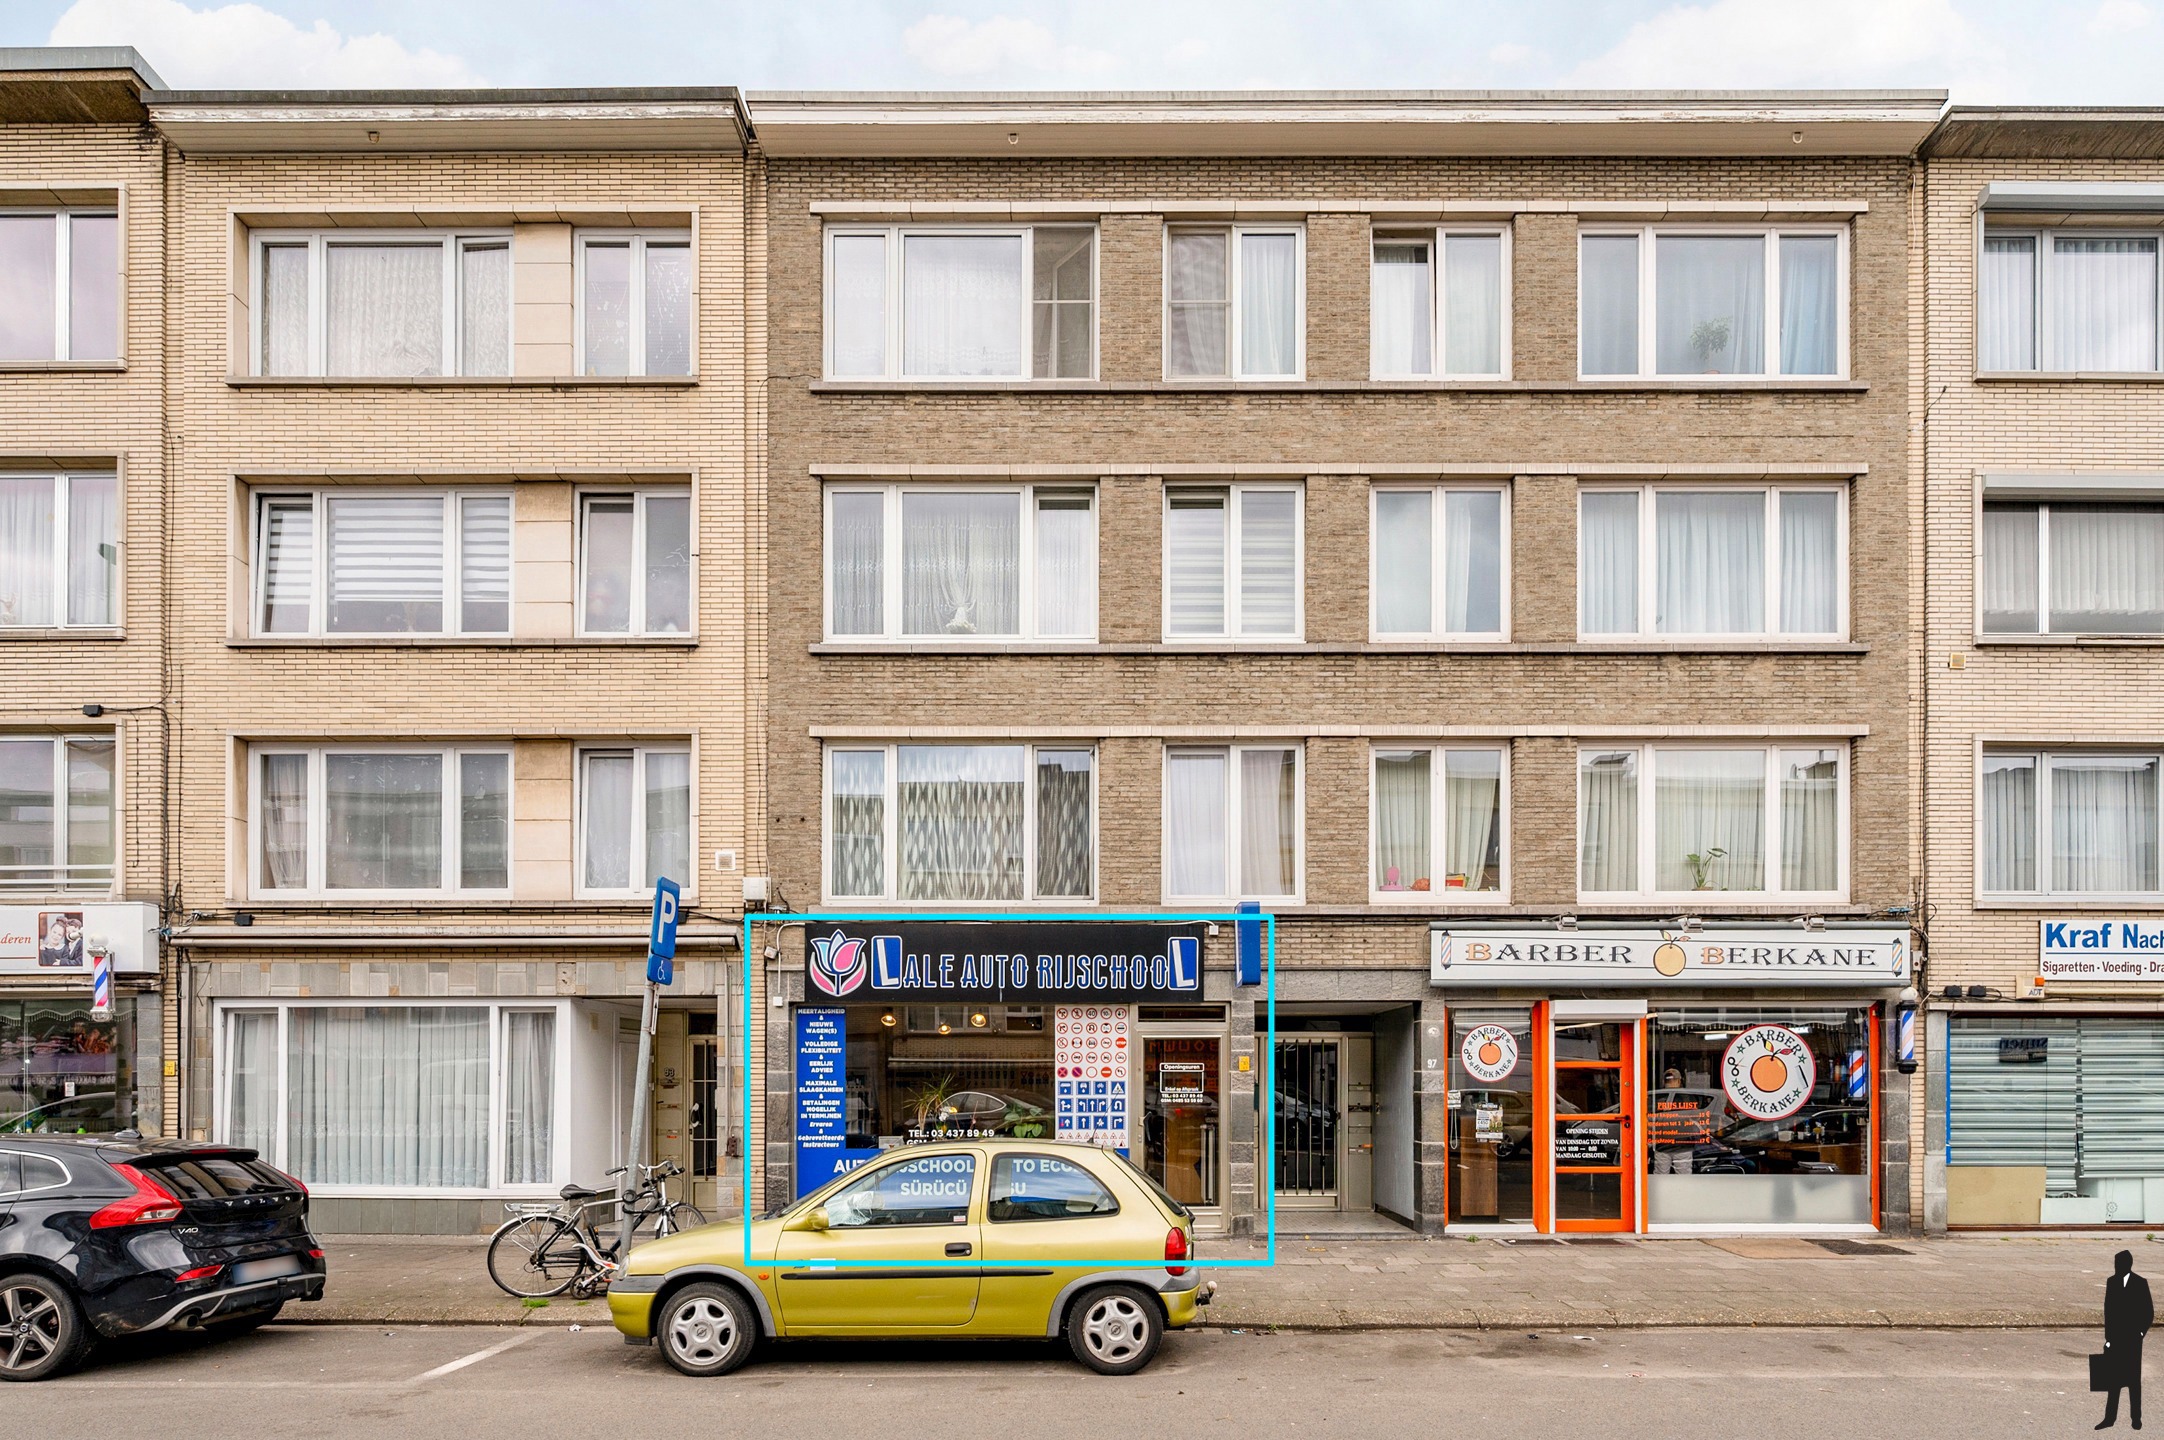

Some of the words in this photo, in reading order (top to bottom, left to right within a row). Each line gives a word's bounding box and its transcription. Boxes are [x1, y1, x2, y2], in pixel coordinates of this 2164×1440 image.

[657, 890, 676, 944] P
[0, 933, 31, 944] deren
[2045, 923, 2112, 948] Kraf
[1466, 943, 1633, 964] BARBER
[1701, 946, 1877, 967] BERKANE
[872, 936, 955, 989] LALE
[960, 954, 1029, 989] AUTO
[1036, 937, 1199, 990] RIJSCHOOL
[2042, 961, 2095, 975] Sigaretten
[2102, 961, 2142, 975] Voeding
[2028, 988, 2043, 996] ADT
[1086, 1009, 1096, 1017] 40
[1470, 1027, 1507, 1040] BARBER
[1744, 1029, 1802, 1055] BARBER
[1427, 1059, 1437, 1069] 97
[1473, 1063, 1509, 1078] BERKANE
[1737, 1085, 1796, 1114] BERKANE
[908, 1129, 930, 1138] TEL.:
[930, 1129, 945, 1138] 03
[946, 1129, 965, 1138] 437
[966, 1129, 980, 1138] 89
[981, 1129, 996, 1138] 49
[833, 1159, 868, 1173] AUT
[1040, 1159, 1079, 1173] ECO
[900, 1179, 967, 1196] SÜRÜCÜ
[225, 1196, 291, 1207] VOLVO
[178, 1227, 199, 1235] V40
